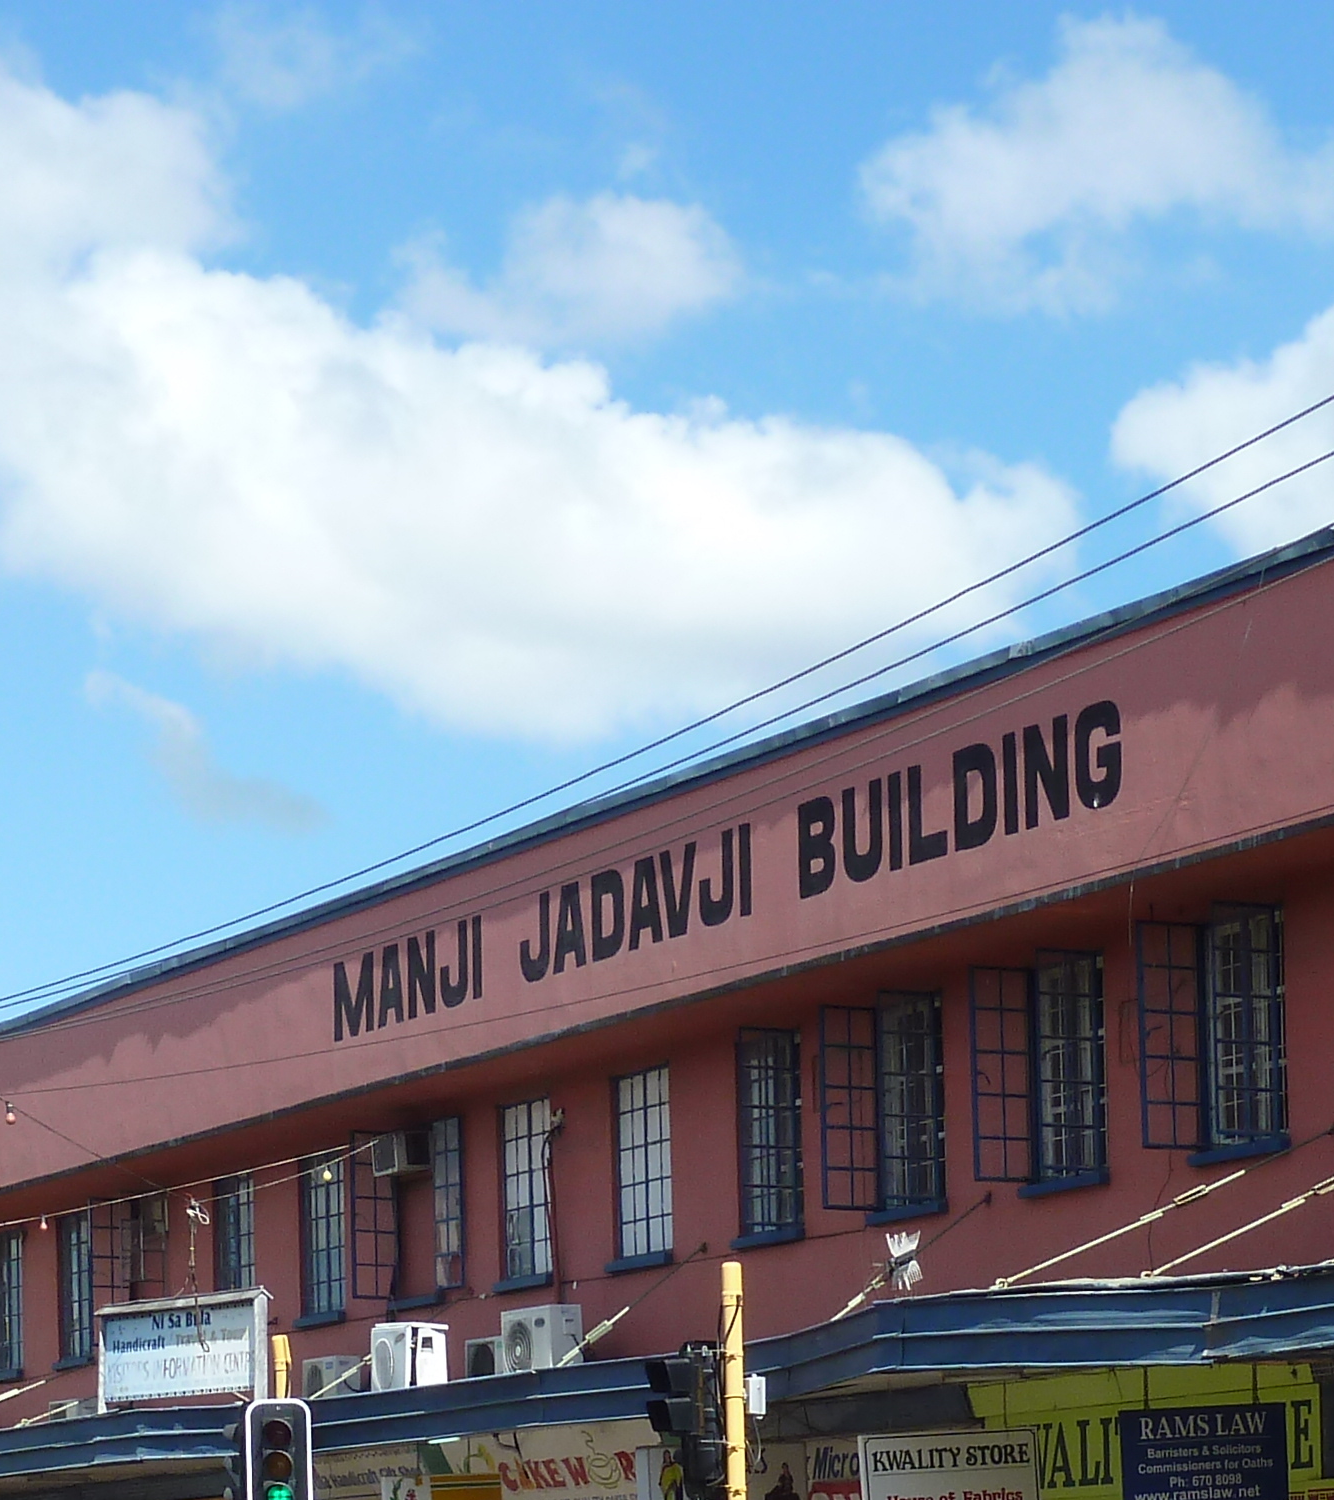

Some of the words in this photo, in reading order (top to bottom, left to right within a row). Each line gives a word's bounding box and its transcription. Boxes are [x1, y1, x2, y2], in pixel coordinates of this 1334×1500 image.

[332, 915, 482, 1042] MANJI
[519, 822, 752, 984] JADAVJI
[797, 700, 1122, 899] BUILDING
[168, 1313, 182, 1329] Sa
[113, 1335, 165, 1353] Handicraft
[1139, 1414, 1210, 1440] RAMS
[1215, 1411, 1267, 1436] LAW
[873, 1446, 960, 1472] KWALITY
[966, 1442, 1030, 1466] STORE
[1147, 1445, 1199, 1459] Barristers
[1202, 1444, 1209, 1456] &
[1212, 1443, 1262, 1455] Solicitors
[813, 1448, 859, 1479] Micro
[1138, 1458, 1221, 1474] Commissioners
[1224, 1457, 1239, 1469] for
[1242, 1456, 1273, 1469] Oaths
[1192, 1474, 1213, 1487] 670
[1216, 1472, 1242, 1486] 8098
